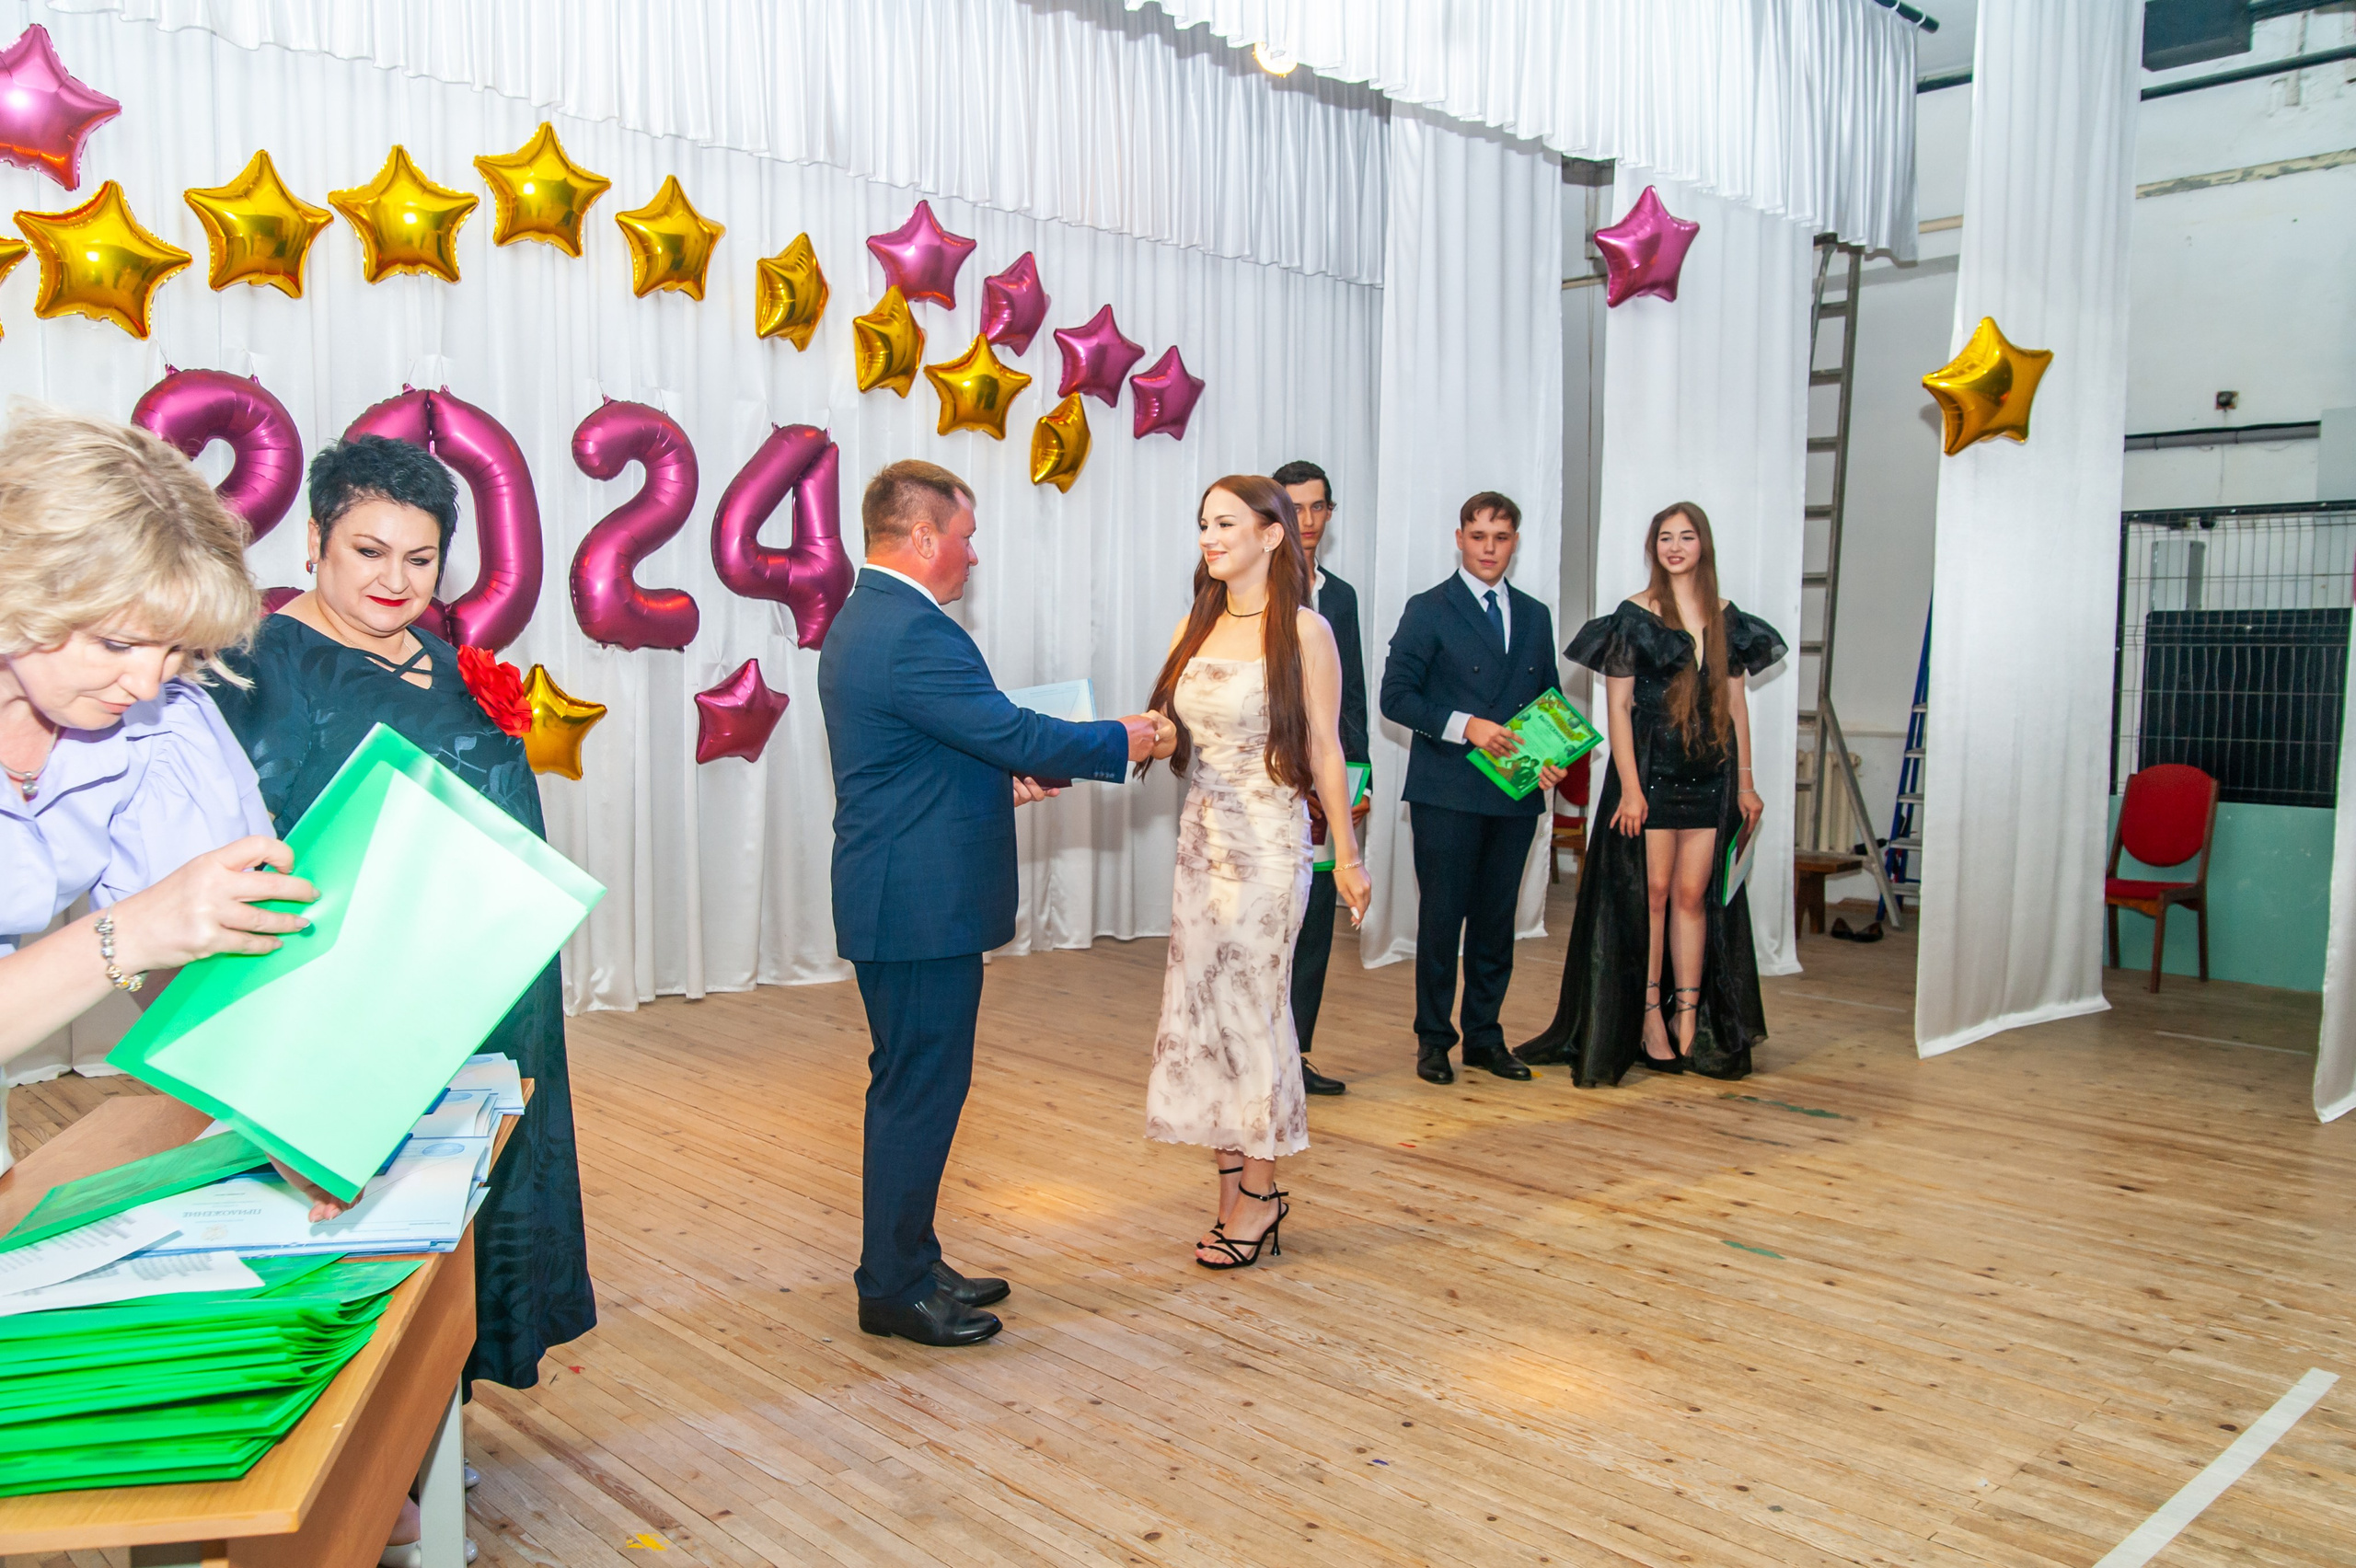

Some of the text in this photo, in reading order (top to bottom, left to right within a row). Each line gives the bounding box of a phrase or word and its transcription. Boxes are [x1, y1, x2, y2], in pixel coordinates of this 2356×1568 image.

[132, 364, 854, 651] 2024
[1538, 714, 1567, 744] ВЫПУСКНИКА
[1551, 712, 1576, 739] ДИПЛОМ
[182, 1208, 262, 1218] ПРИЛОЖЕНИЕ
